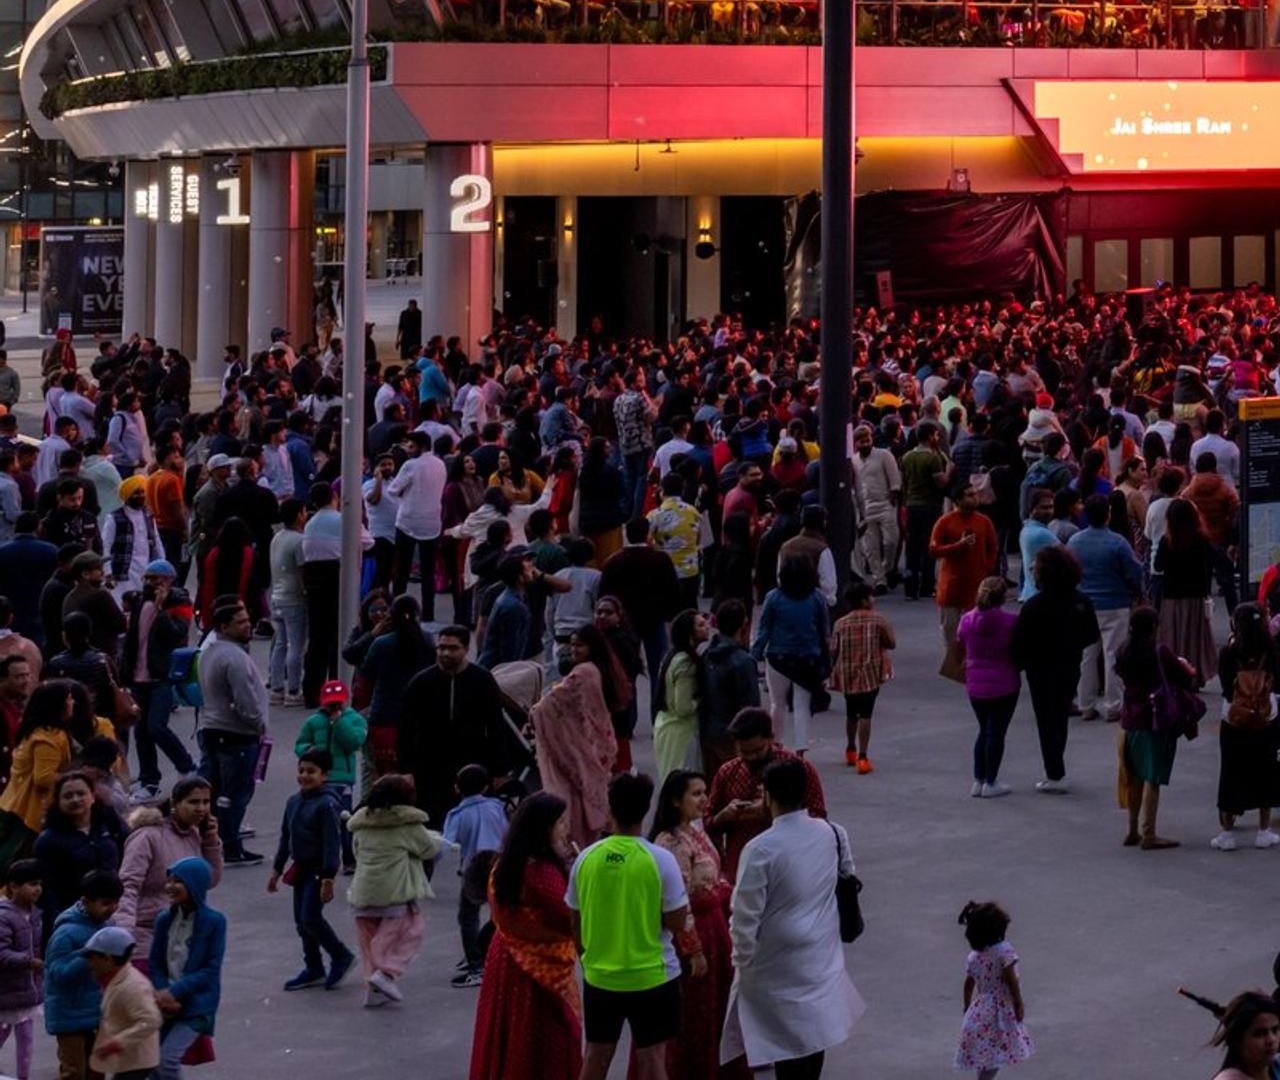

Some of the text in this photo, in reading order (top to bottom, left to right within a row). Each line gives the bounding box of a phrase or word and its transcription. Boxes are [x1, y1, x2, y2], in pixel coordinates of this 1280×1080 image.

[170, 166, 183, 223] SERVICES
[186, 175, 199, 213] GUEST
[216, 178, 250, 224] 1
[450, 174, 491, 232] 2
